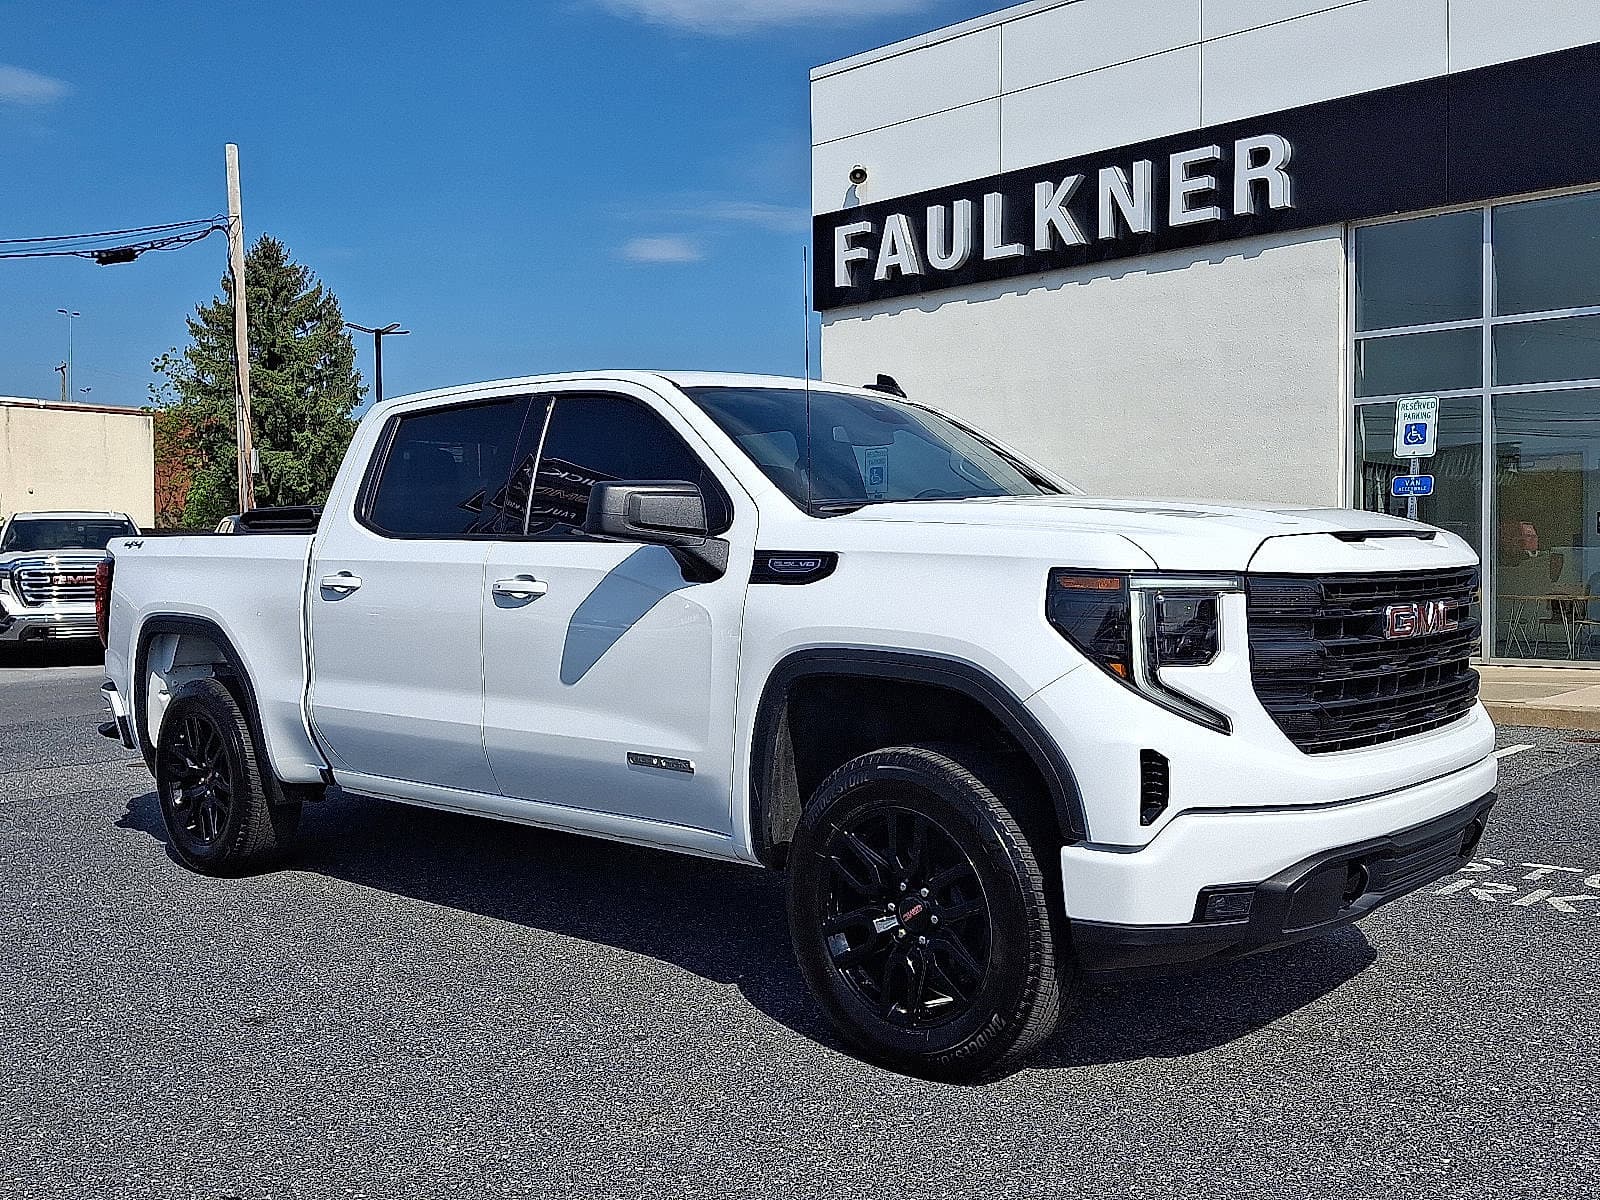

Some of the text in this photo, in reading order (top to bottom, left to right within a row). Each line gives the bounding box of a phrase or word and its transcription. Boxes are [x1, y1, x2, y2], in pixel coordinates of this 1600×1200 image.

[834, 133, 1293, 288] FAULKNER
[1400, 401, 1436, 412] RESERVED
[1403, 411, 1432, 421] PARKING
[1384, 600, 1459, 640] GMC
